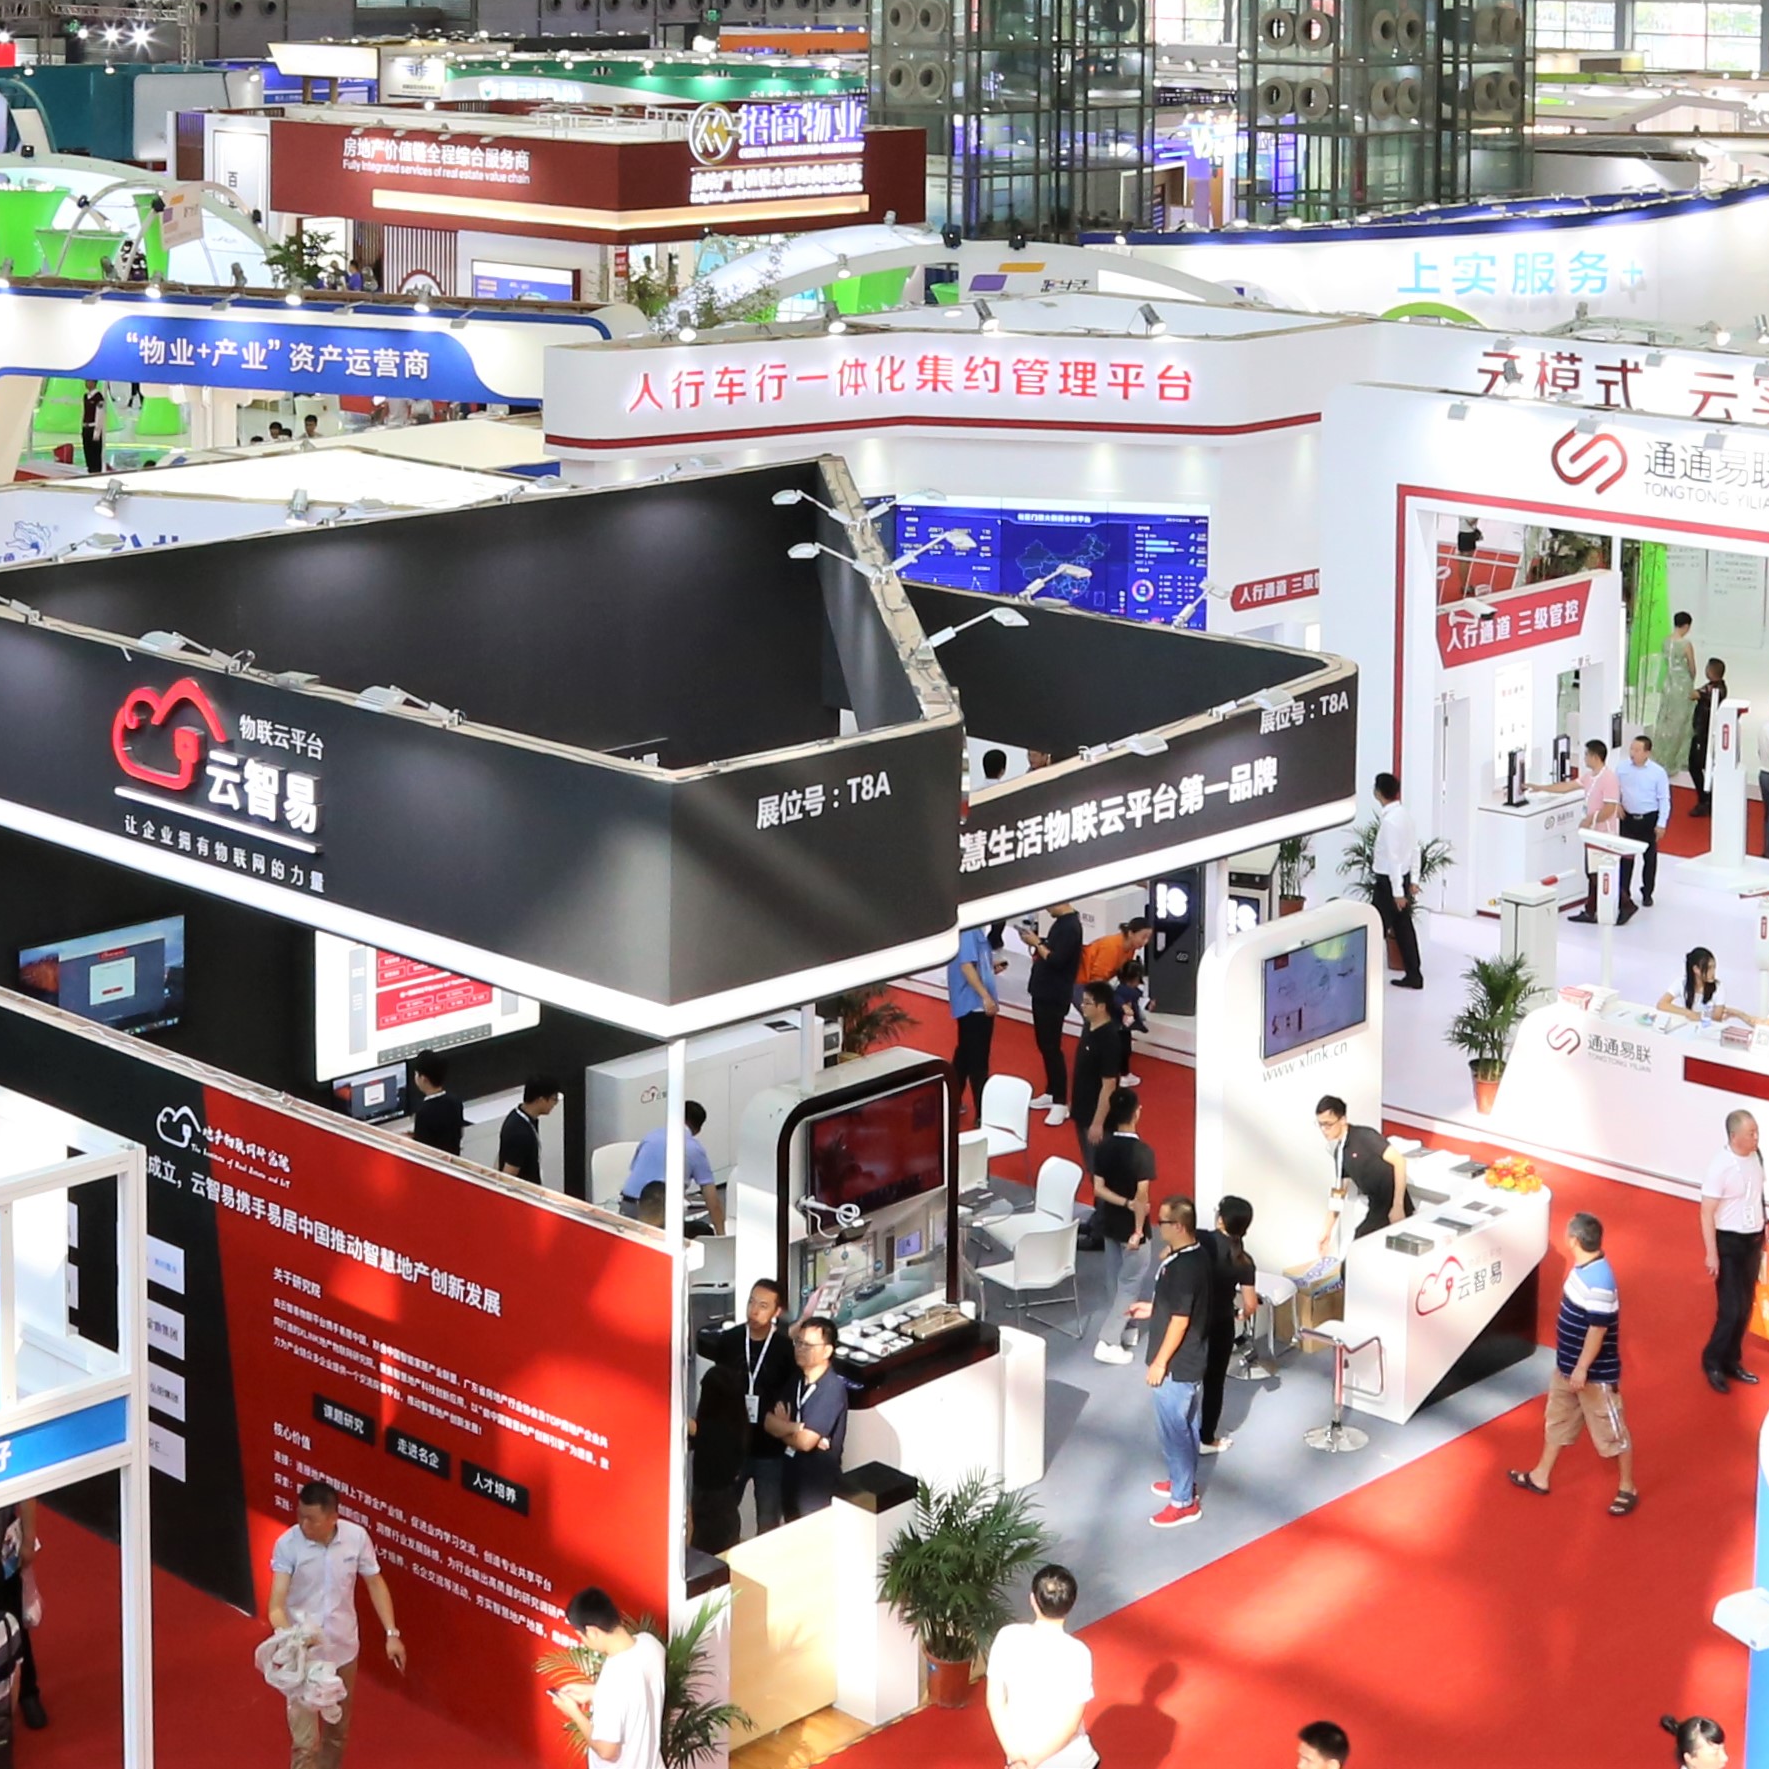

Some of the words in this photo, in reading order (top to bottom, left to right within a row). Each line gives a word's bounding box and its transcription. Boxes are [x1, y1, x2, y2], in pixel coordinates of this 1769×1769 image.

[629, 352, 1195, 414] 人行车行一体化集约管理平台
[1517, 599, 1580, 636] 三级管控
[238, 713, 324, 761] 物联云平台
[206, 749, 322, 835] 云智易
[123, 814, 326, 894] 让企业拥有物联网的力量
[1261, 1039, 1350, 1084] www.xlink.cn
[1588, 1034, 1653, 1065] 通通易联
[273, 1422, 311, 1451] 核心价值
[397, 1438, 440, 1469] 走进名企
[473, 1472, 517, 1503] 人才培养
